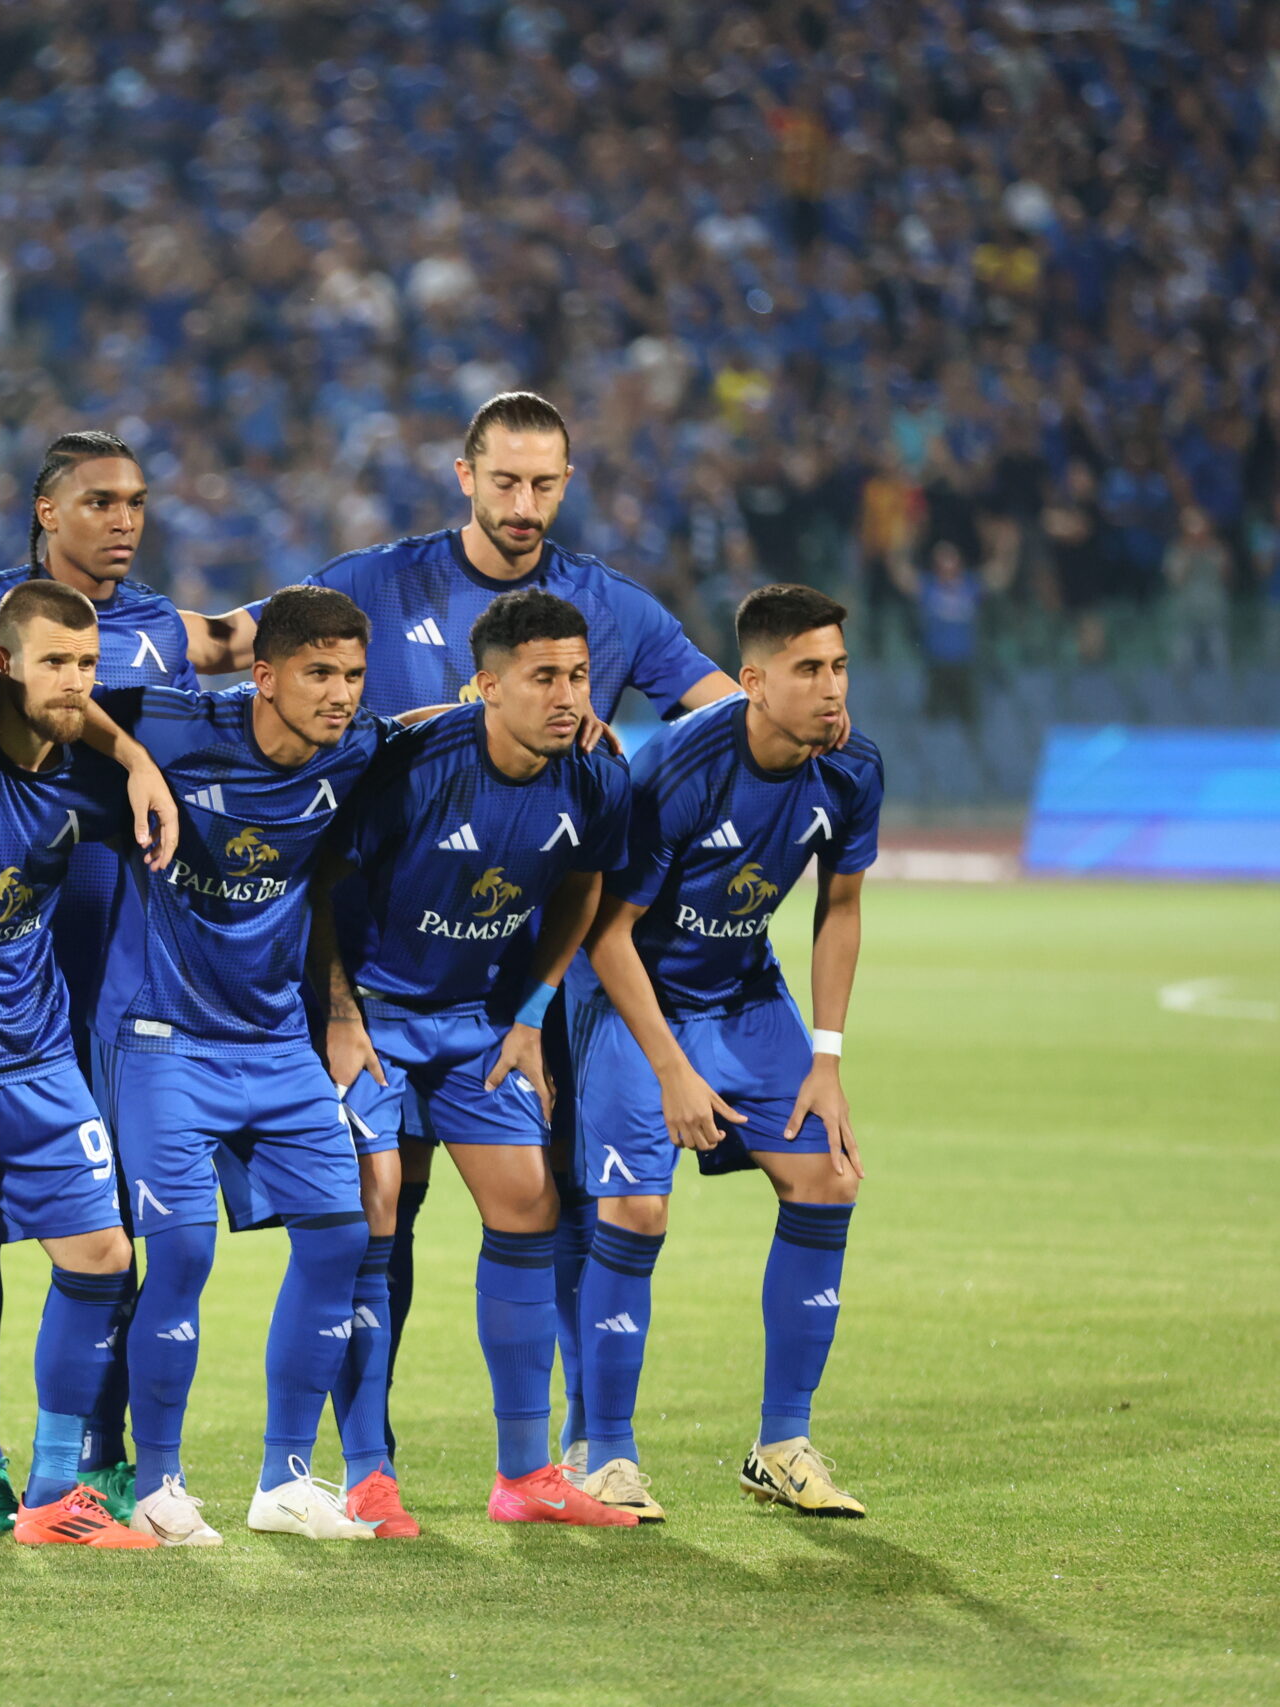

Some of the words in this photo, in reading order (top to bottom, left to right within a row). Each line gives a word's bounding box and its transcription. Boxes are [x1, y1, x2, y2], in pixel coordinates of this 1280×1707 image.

[167, 859, 255, 901] PALMS
[417, 910, 501, 940] PALMS
[675, 904, 756, 937] PALMS
